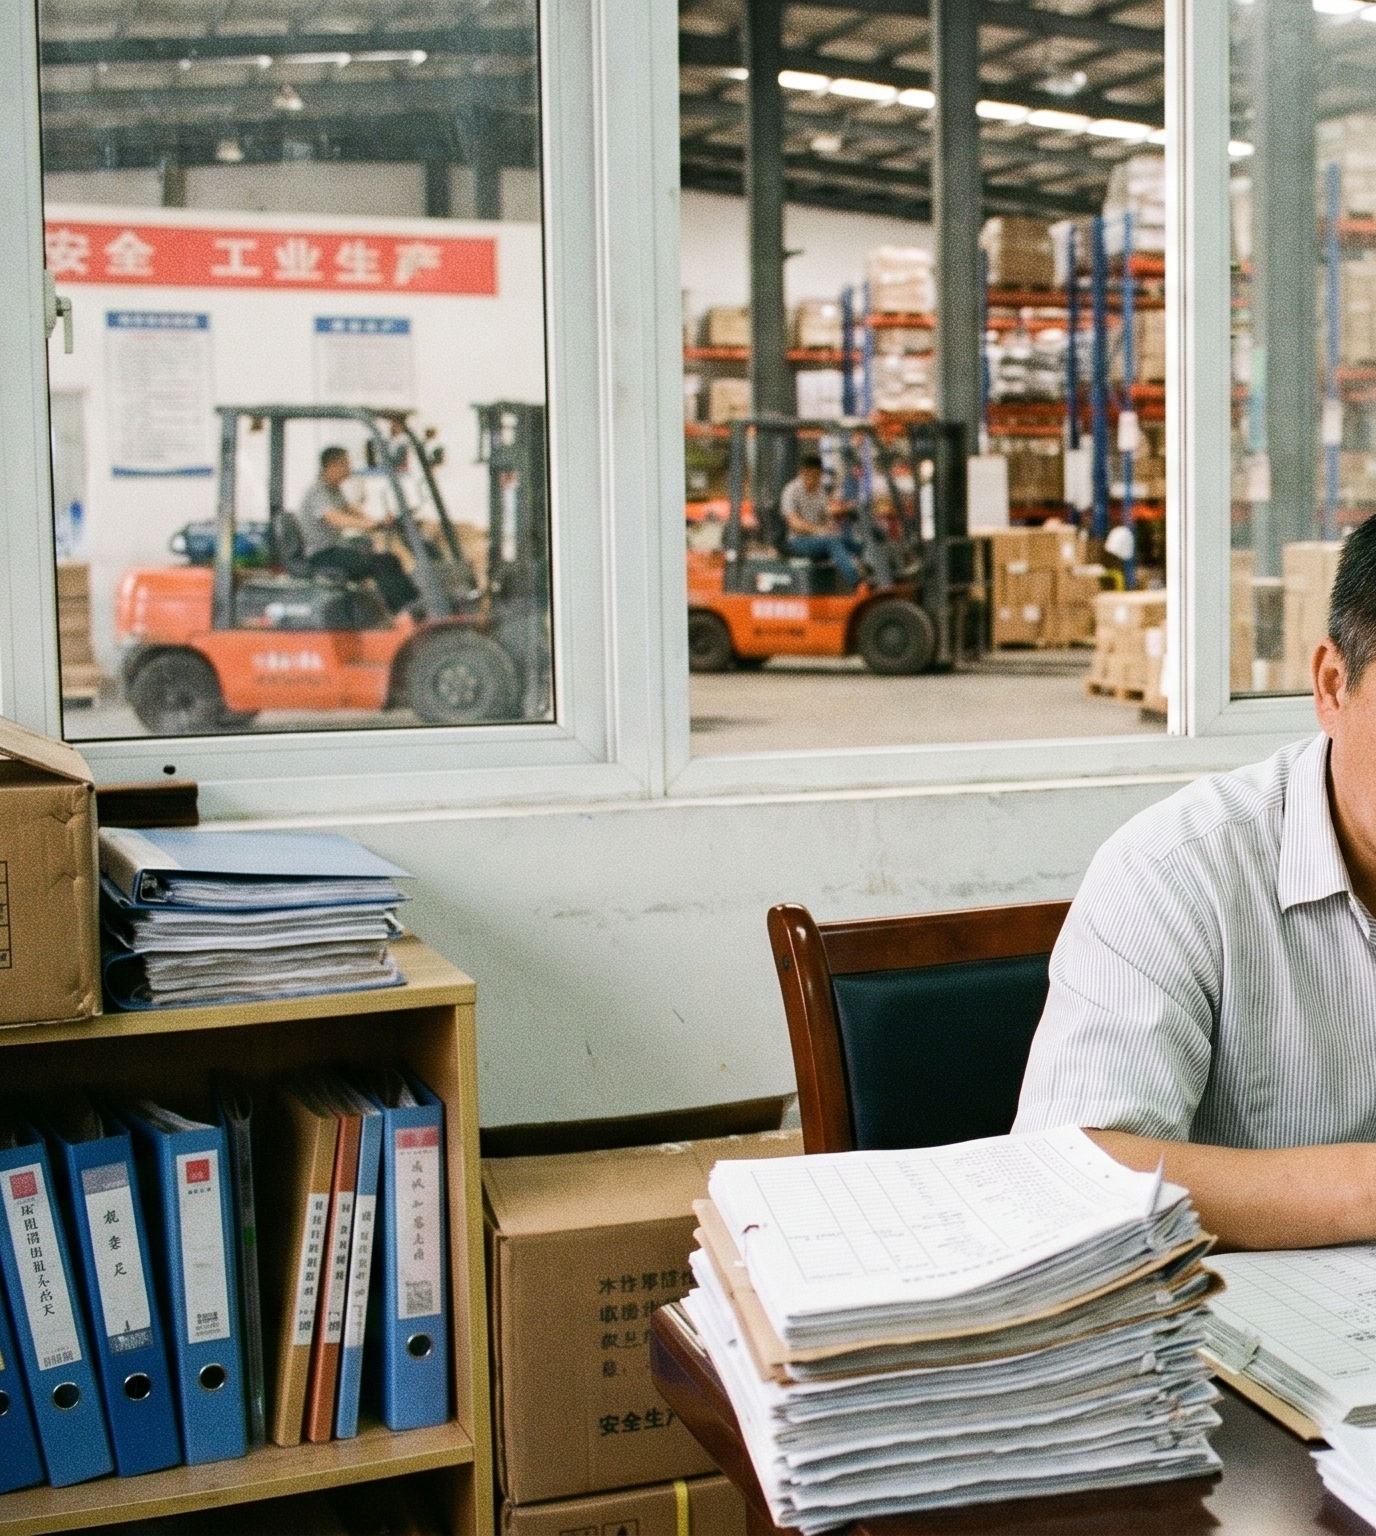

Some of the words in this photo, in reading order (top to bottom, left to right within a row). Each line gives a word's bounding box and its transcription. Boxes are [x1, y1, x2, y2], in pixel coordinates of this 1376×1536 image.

[47, 229, 155, 276] 安全
[210, 237, 442, 285] 工业生产
